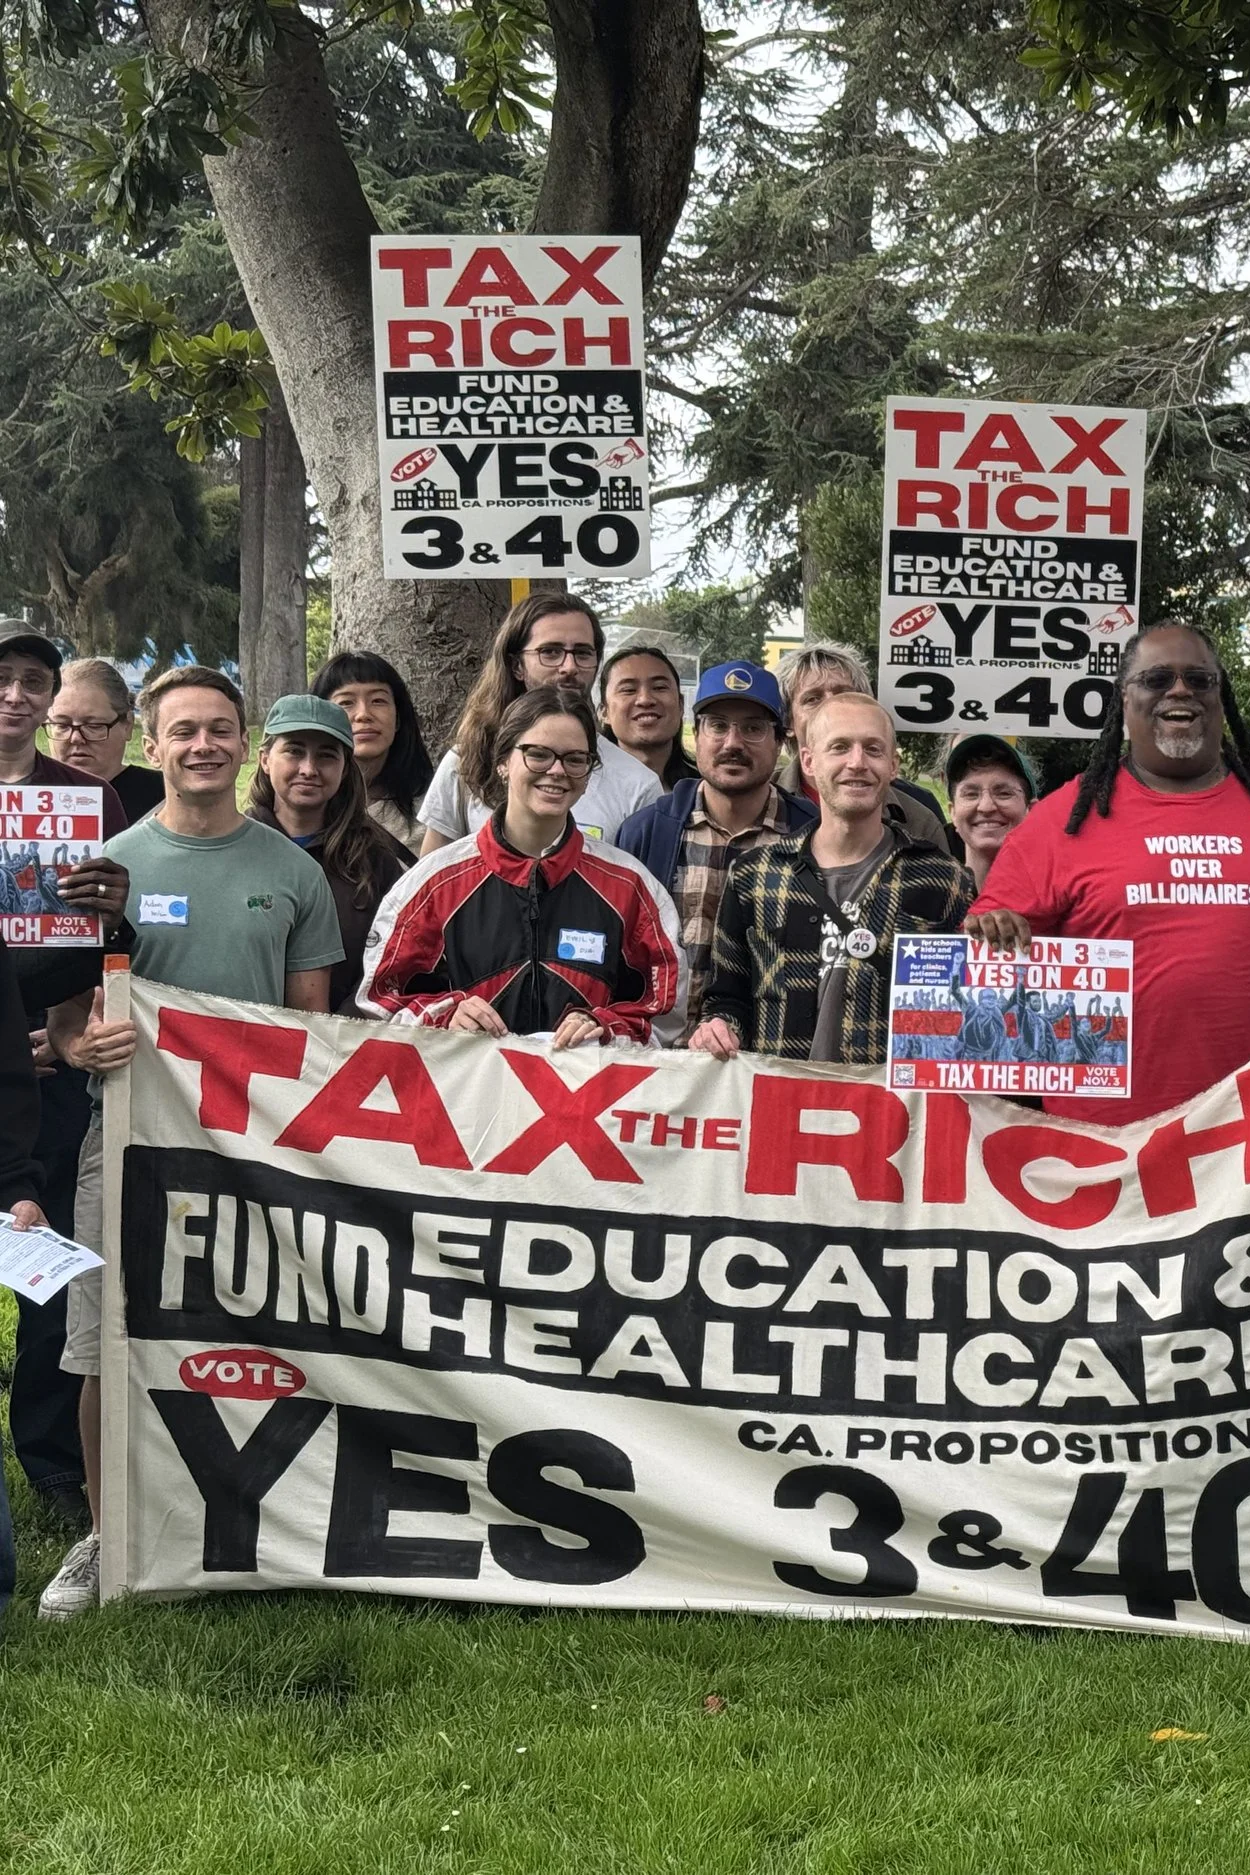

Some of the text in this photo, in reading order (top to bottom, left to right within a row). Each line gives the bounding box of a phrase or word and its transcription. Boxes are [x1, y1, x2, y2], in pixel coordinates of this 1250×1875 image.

[378, 246, 624, 308] TAX
[468, 305, 517, 317] THE
[387, 317, 631, 368] RICH
[459, 375, 558, 393] FUND
[390, 395, 630, 415] EDUCATION &
[392, 416, 635, 436] HEALTHCARE
[893, 409, 1128, 476] TAX
[394, 449, 435, 479] VOTE
[436, 442, 601, 498] YES
[977, 470, 1023, 483] THE
[897, 479, 1130, 534] RICH
[401, 514, 639, 569] 3 & 40
[962, 538, 1058, 558] FUND
[893, 555, 1123, 582] EDUCATION &
[895, 576, 1127, 601] HEALTHCARE
[892, 606, 935, 635] VOTE
[936, 603, 1091, 661] YES
[894, 671, 1114, 730] 3 & 40
[37, 791, 53, 813] 3
[36, 816, 73, 839] 40
[1144, 835, 1243, 855] WORKERS
[1170, 858, 1223, 878] OVER
[51, 927, 91, 935] NOV. 3
[54, 917, 87, 925] VOTE
[851, 942, 870, 952] 40
[854, 933, 871, 941] YES
[1029, 942, 1062, 963] ON
[1074, 944, 1089, 965] 3
[968, 965, 1106, 990] YES ON 40
[936, 1064, 1074, 1091] TAX THE RICH
[1083, 1076, 1120, 1086] NOV. 3
[1086, 1067, 1117, 1077] VOTE
[157, 1007, 657, 1184] TAX
[610, 1110, 741, 1151] THE
[159, 1190, 390, 1335] FUND
[411, 1210, 1185, 1323] EDUCATION
[190, 1358, 296, 1389] VOTE
[737, 1420, 833, 1458] CA.
[147, 1389, 646, 1586] YES
[772, 1465, 918, 1597] 3
[927, 1510, 1032, 1570] &
